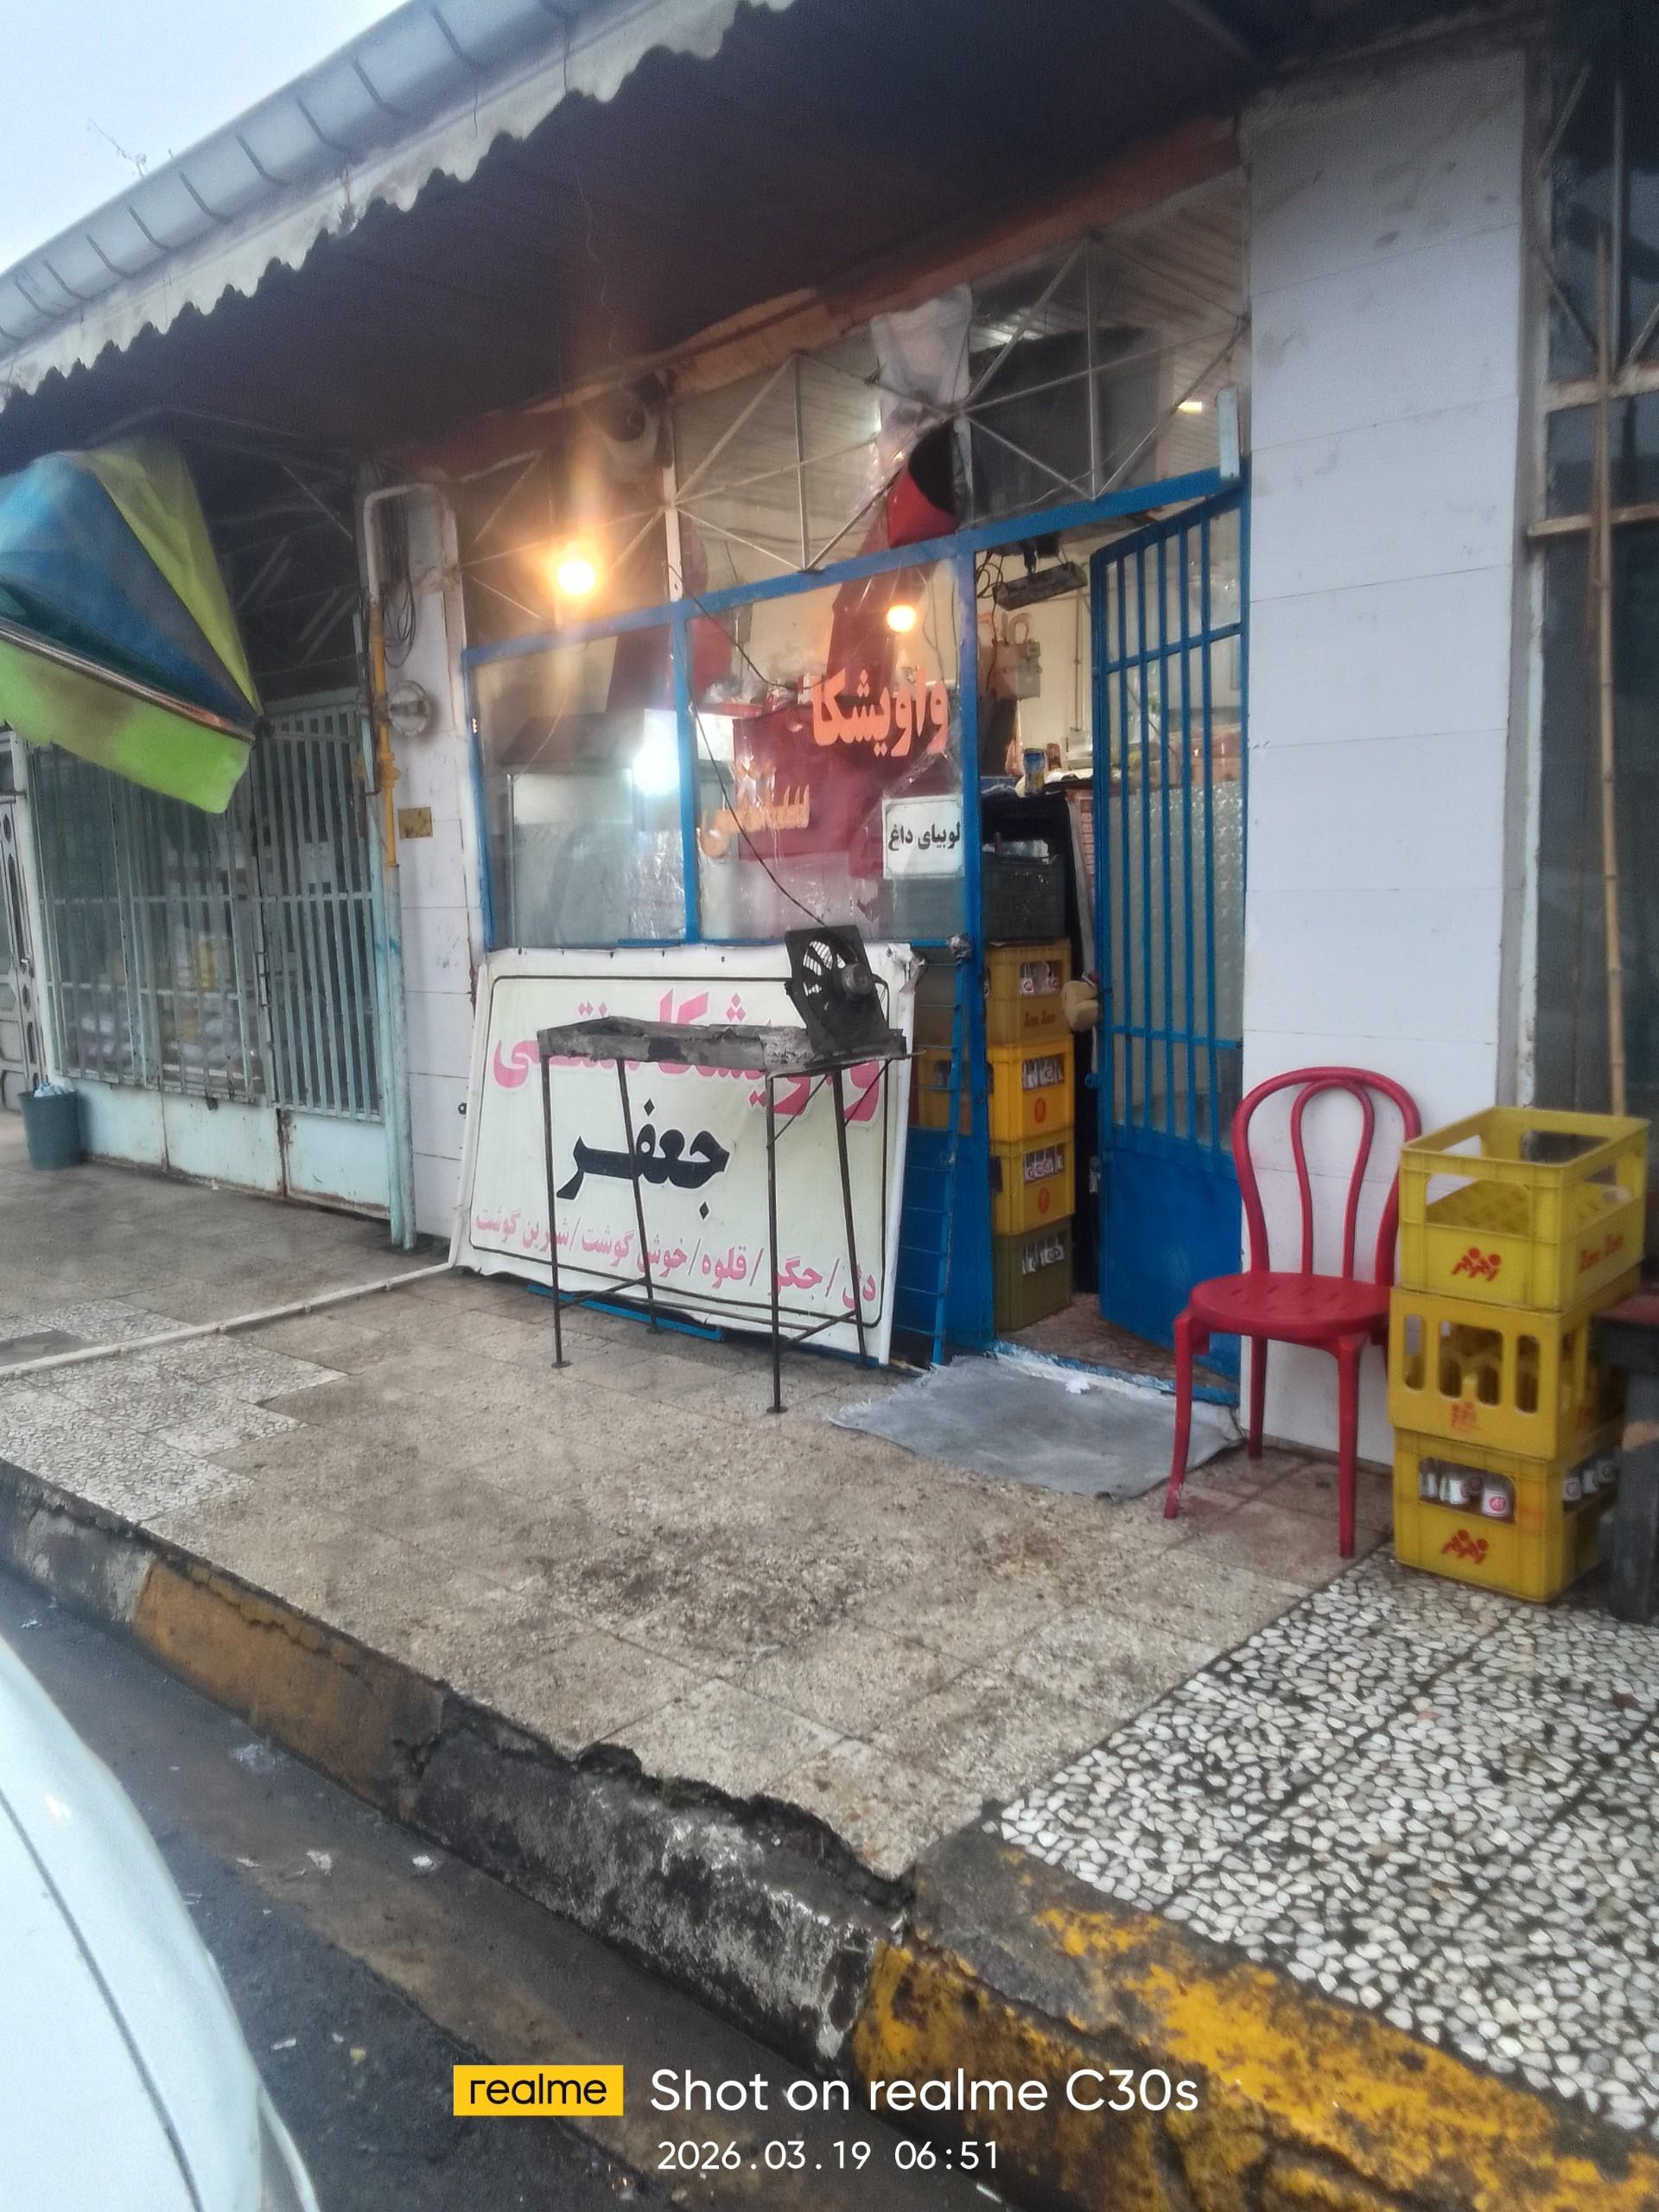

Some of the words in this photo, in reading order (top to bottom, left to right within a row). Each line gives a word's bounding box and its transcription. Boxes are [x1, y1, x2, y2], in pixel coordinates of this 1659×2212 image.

[888, 823, 913, 851] داغ
[918, 821, 960, 850] لوبیای
[556, 1098, 730, 1221] جعفر
[475, 1206, 521, 1243] گوشت
[581, 1225, 634, 1268] گوشت
[636, 1233, 688, 1279] خوش
[701, 1244, 748, 1289] قلوه
